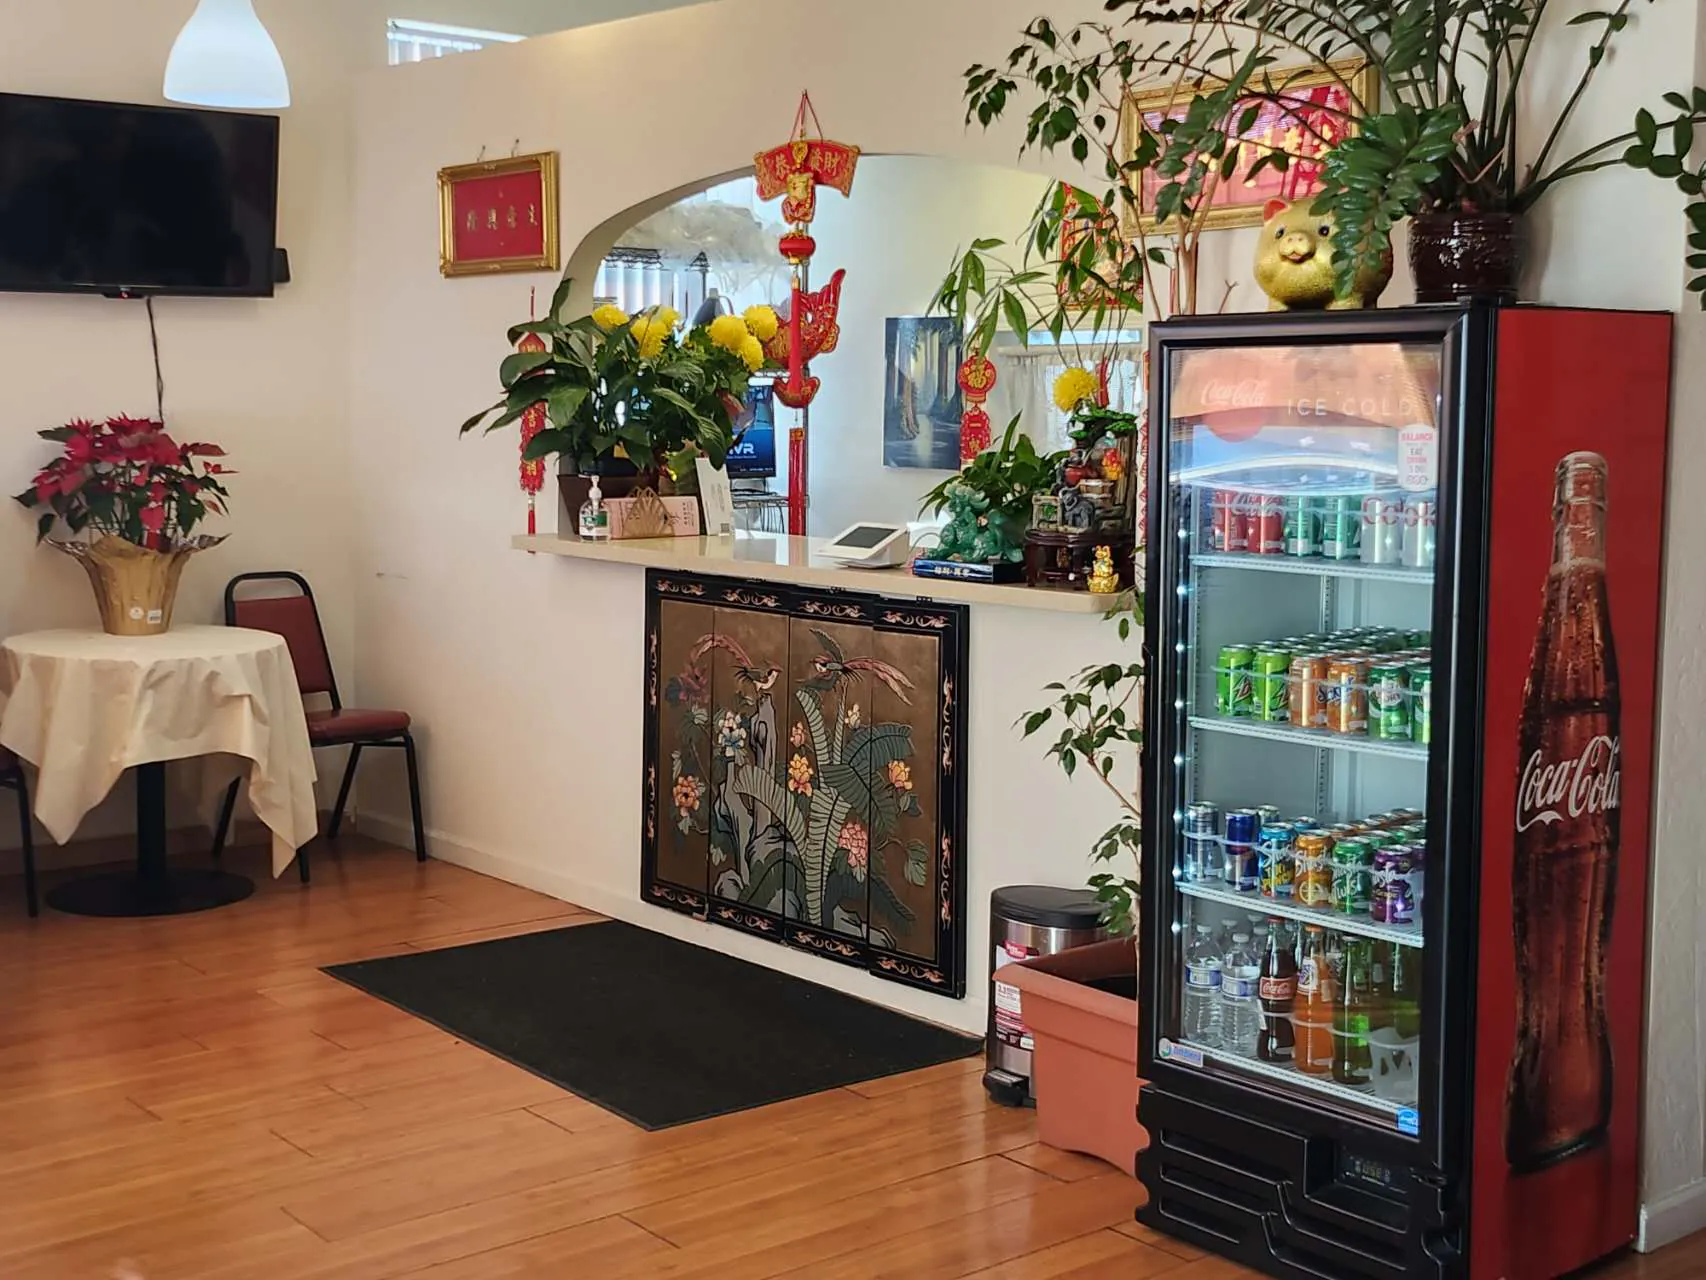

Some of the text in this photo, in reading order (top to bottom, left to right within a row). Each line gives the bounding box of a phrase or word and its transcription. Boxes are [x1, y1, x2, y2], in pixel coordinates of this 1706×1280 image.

[775, 147, 841, 180] 恭發財
[1201, 379, 1268, 407] Coca-Cola
[1288, 397, 1413, 416] ICE COLD
[728, 443, 754, 455] VR
[1516, 735, 1620, 833] Coca-Cola
